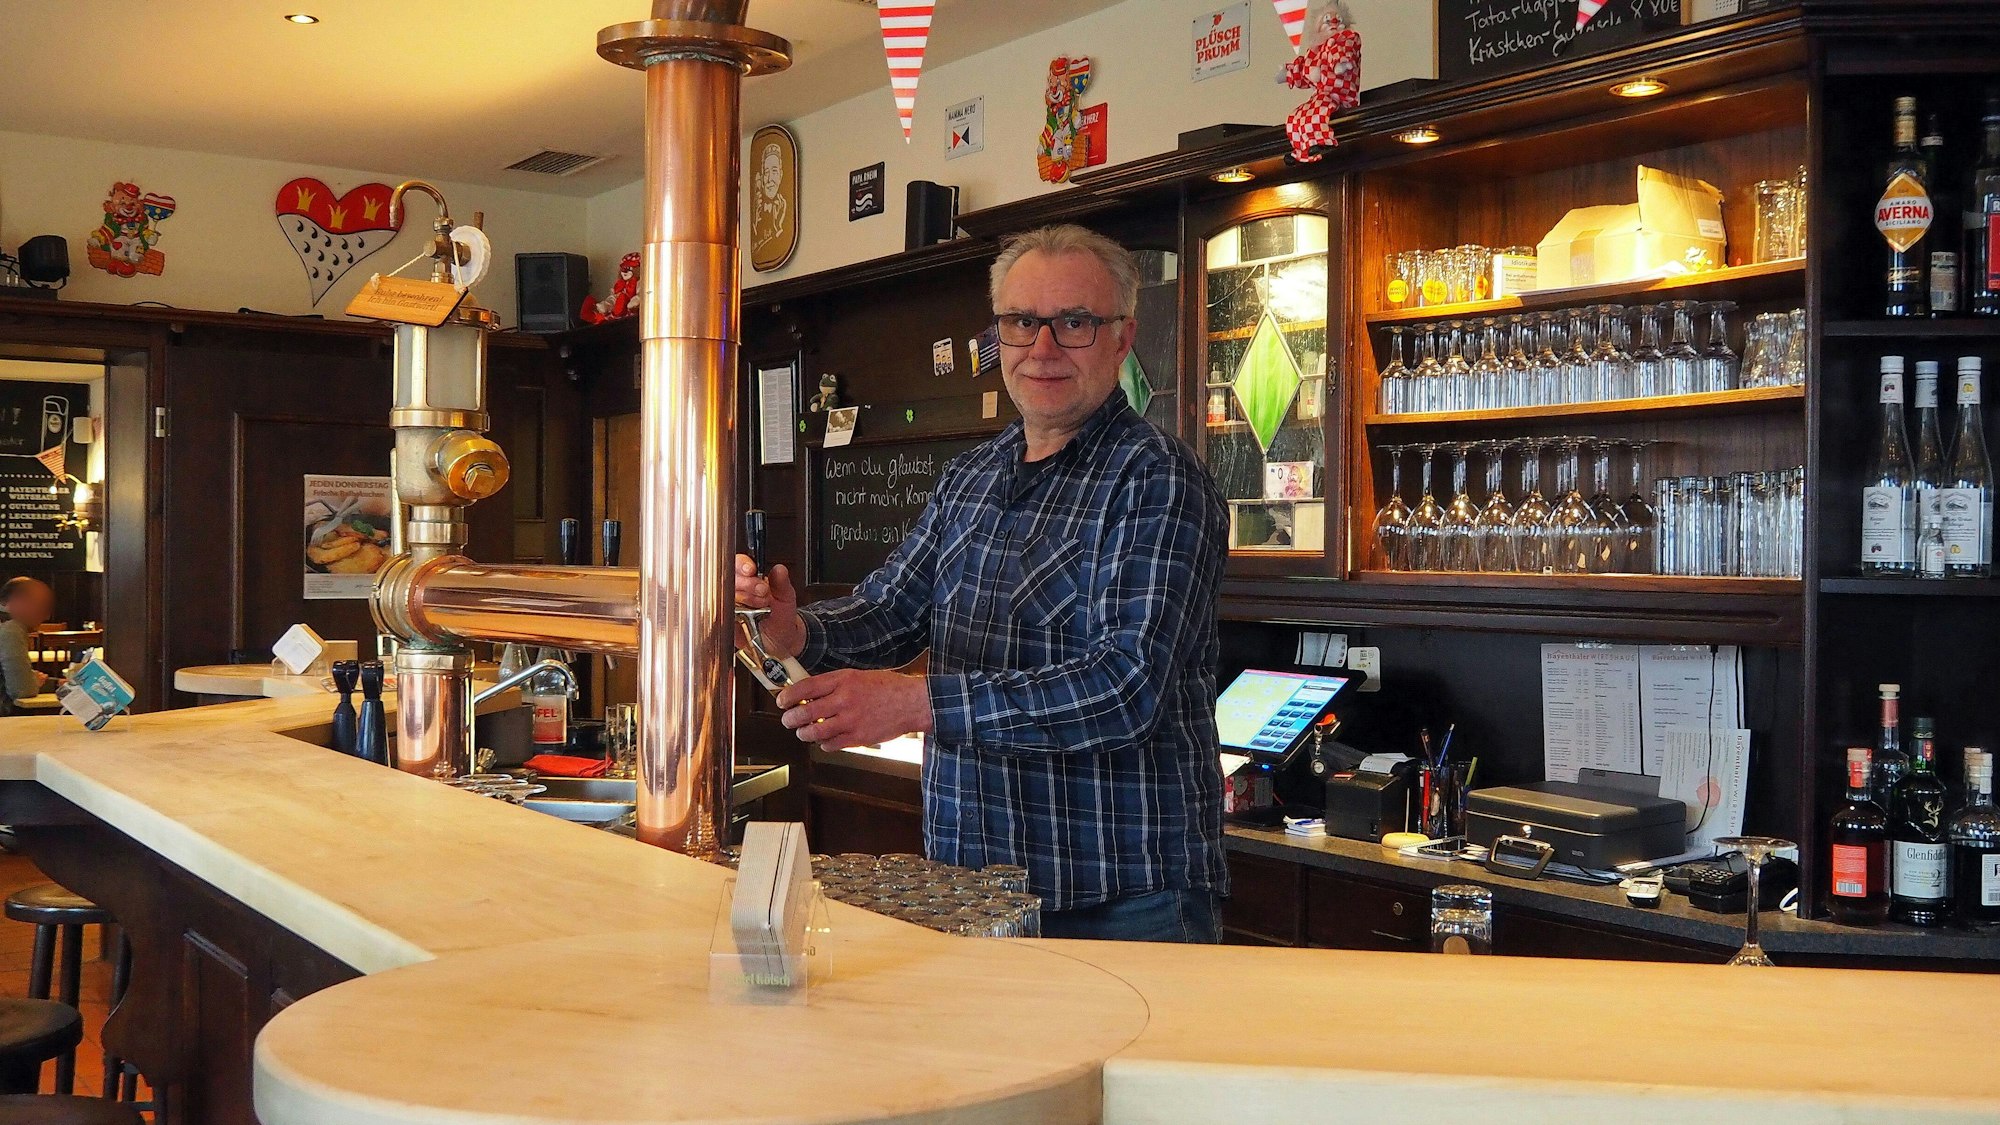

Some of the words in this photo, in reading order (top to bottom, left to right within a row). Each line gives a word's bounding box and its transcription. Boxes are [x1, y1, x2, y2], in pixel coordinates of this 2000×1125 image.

[1195, 25, 1241, 52] PLÜSCH
[1196, 39, 1241, 64] PRUMM
[948, 107, 964, 121] MAMMA
[852, 174, 863, 186] PAPA
[863, 169, 878, 181] RHEIN
[1877, 205, 1930, 223] AVERNA
[1885, 219, 1921, 227] SICILIANO
[825, 457, 857, 480] Wenn
[861, 456, 885, 476] du
[309, 480, 334, 488] JEDEN
[335, 480, 389, 489] DONNERSTAG
[835, 486, 867, 506] nicht
[869, 489, 903, 508] mehr,
[8, 503, 61, 511] GUTELAUNE
[8, 532, 60, 540] BRATWURST
[8, 551, 55, 559] KARNEVAL
[1547, 652, 1590, 661] Bayenthaler
[1590, 652, 1635, 662] WIRTSHAUS
